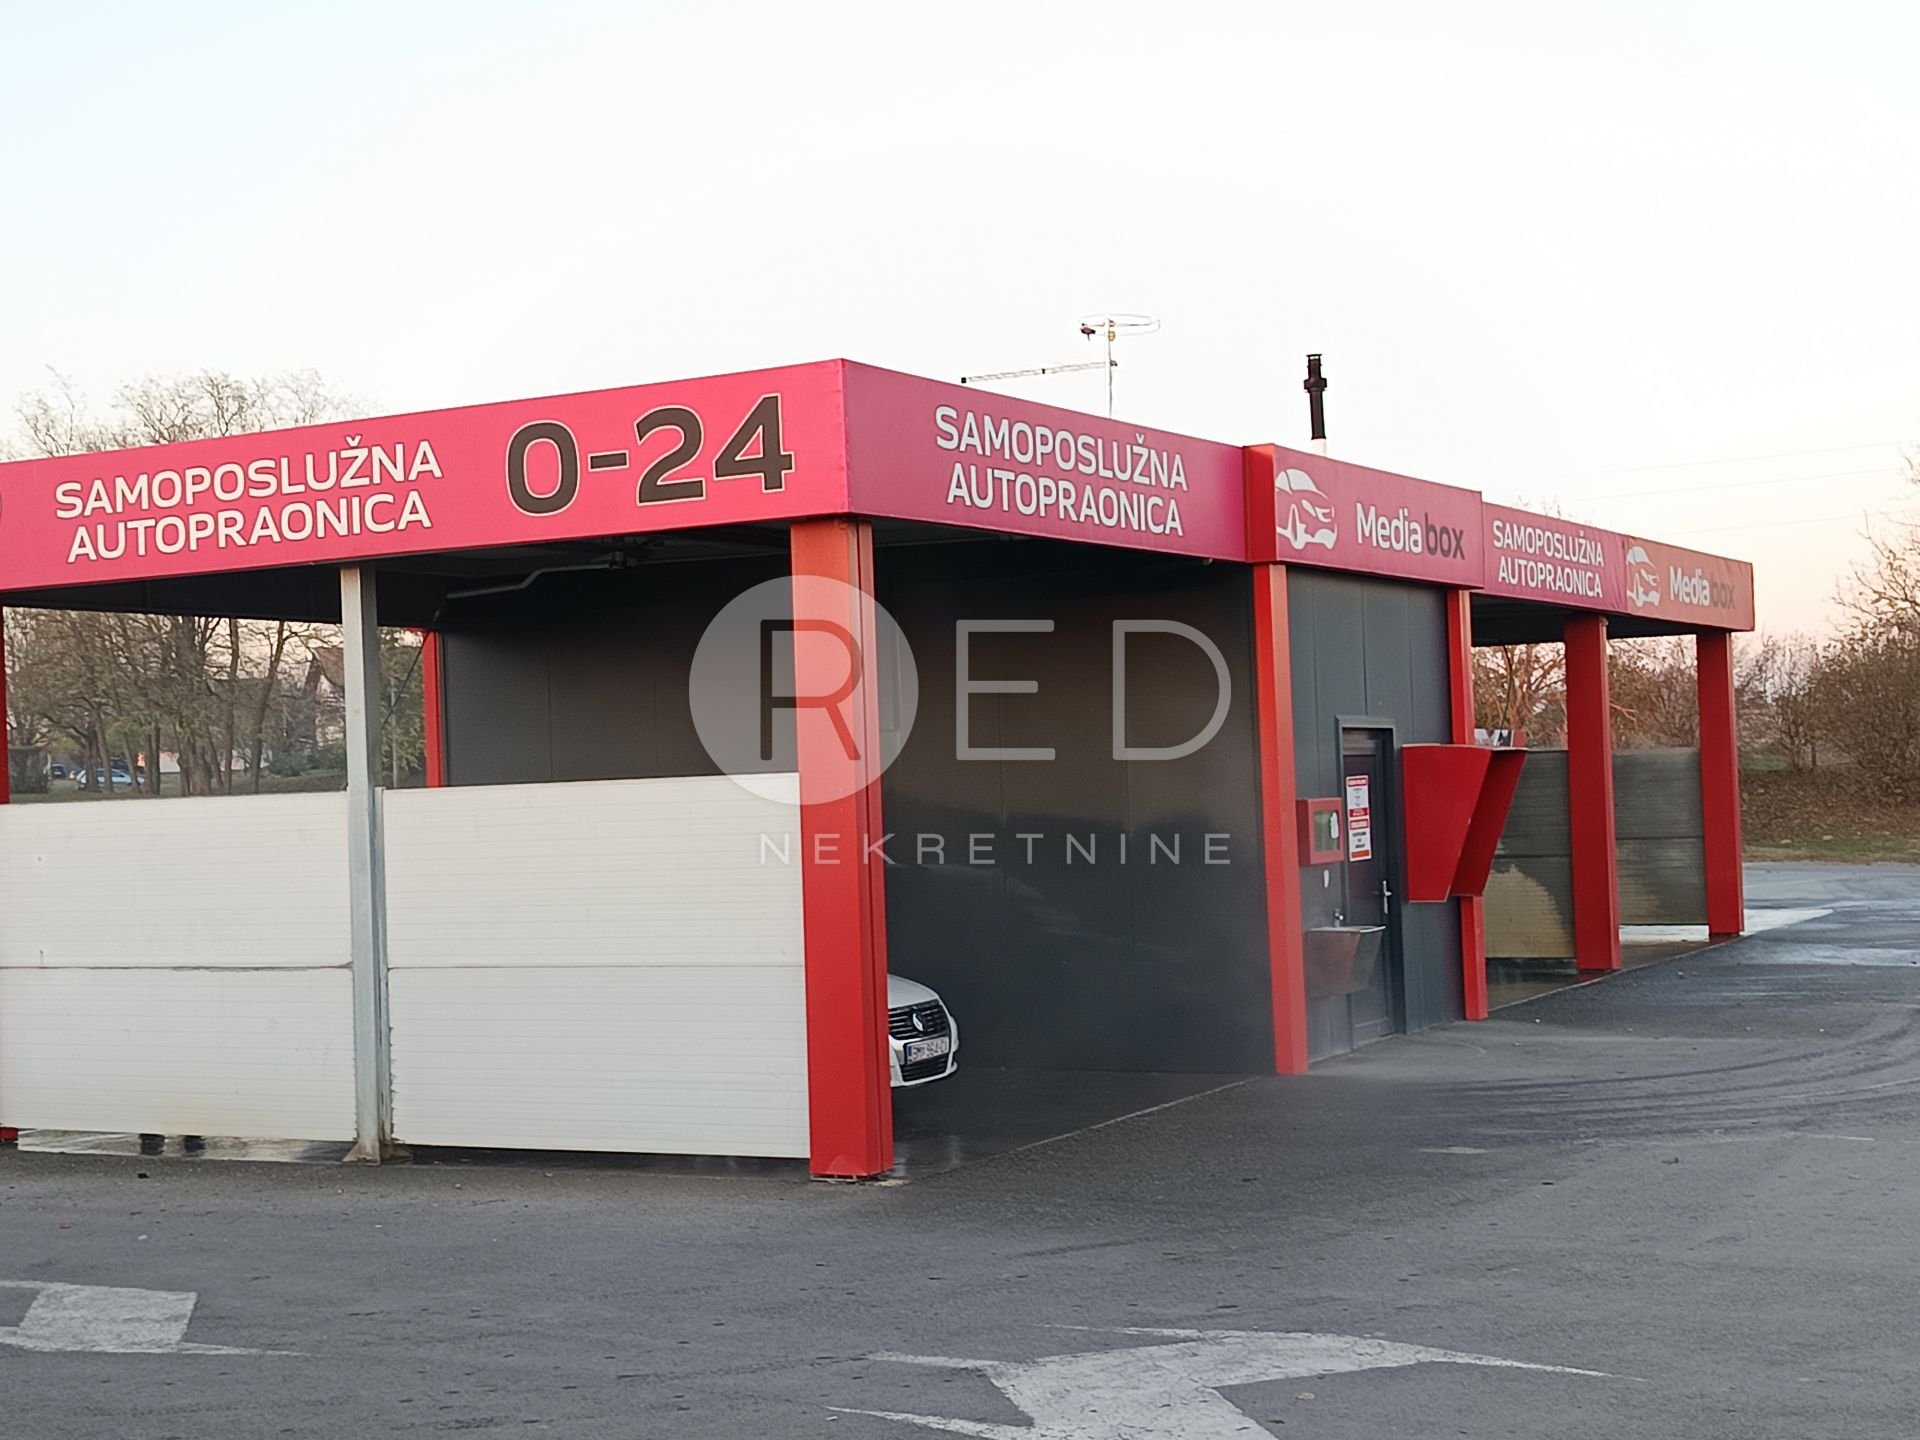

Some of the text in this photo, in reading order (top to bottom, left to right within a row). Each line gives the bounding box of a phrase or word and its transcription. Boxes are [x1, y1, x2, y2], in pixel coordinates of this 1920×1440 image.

[54, 434, 443, 520] SAMOPOSLUŽNA
[505, 391, 795, 517] 0-24
[934, 405, 1189, 491] SAMOPOSLUŽNA
[67, 490, 433, 564] AUTOPRAONICA
[947, 462, 1184, 536] AUTOPRAONICA
[1355, 502, 1466, 560] Mediabox
[1492, 519, 1605, 568] SAMOPOSLUŽNA
[1498, 555, 1603, 598] AUTOPRAONICA
[1669, 565, 1737, 610] Mediabox
